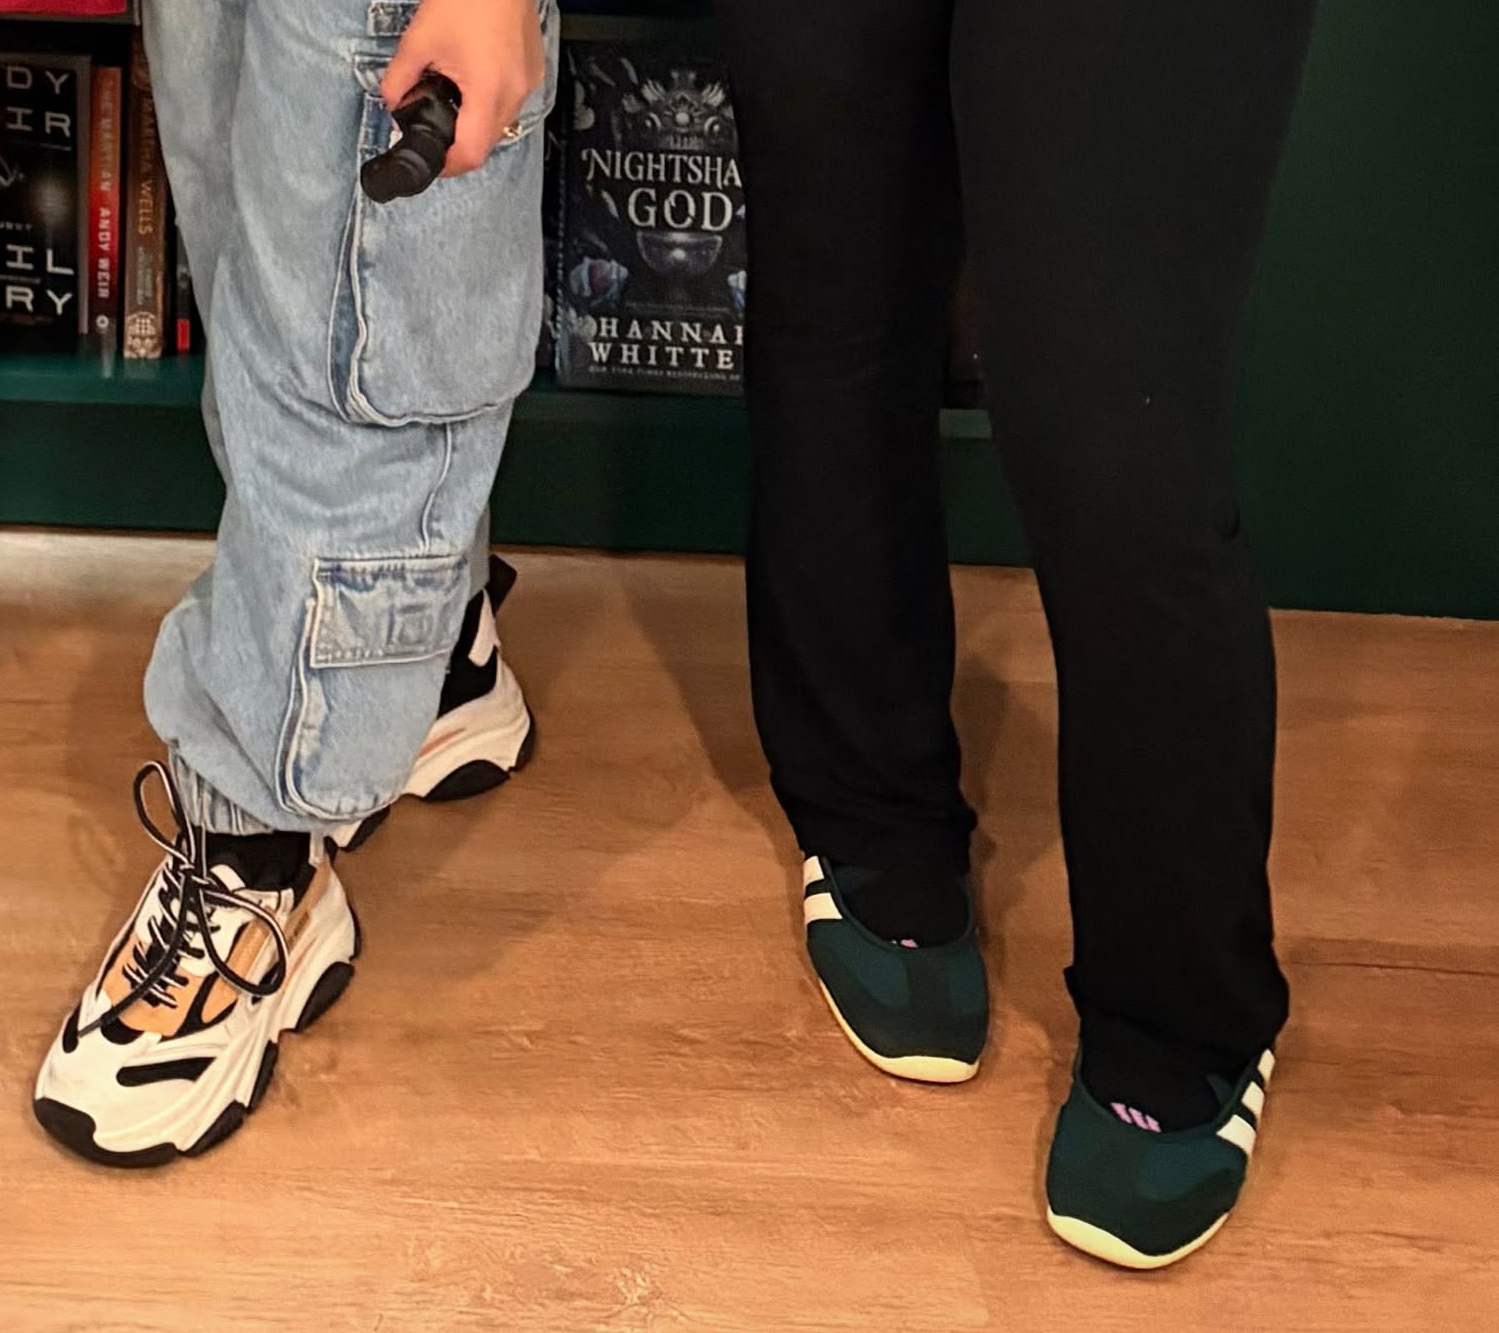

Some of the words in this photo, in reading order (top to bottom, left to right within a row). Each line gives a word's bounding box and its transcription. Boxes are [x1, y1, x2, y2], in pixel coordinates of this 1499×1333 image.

[582, 149, 742, 189] NIGHTSHA
[628, 187, 733, 231] GOD
[589, 342, 734, 370] WHITTE
